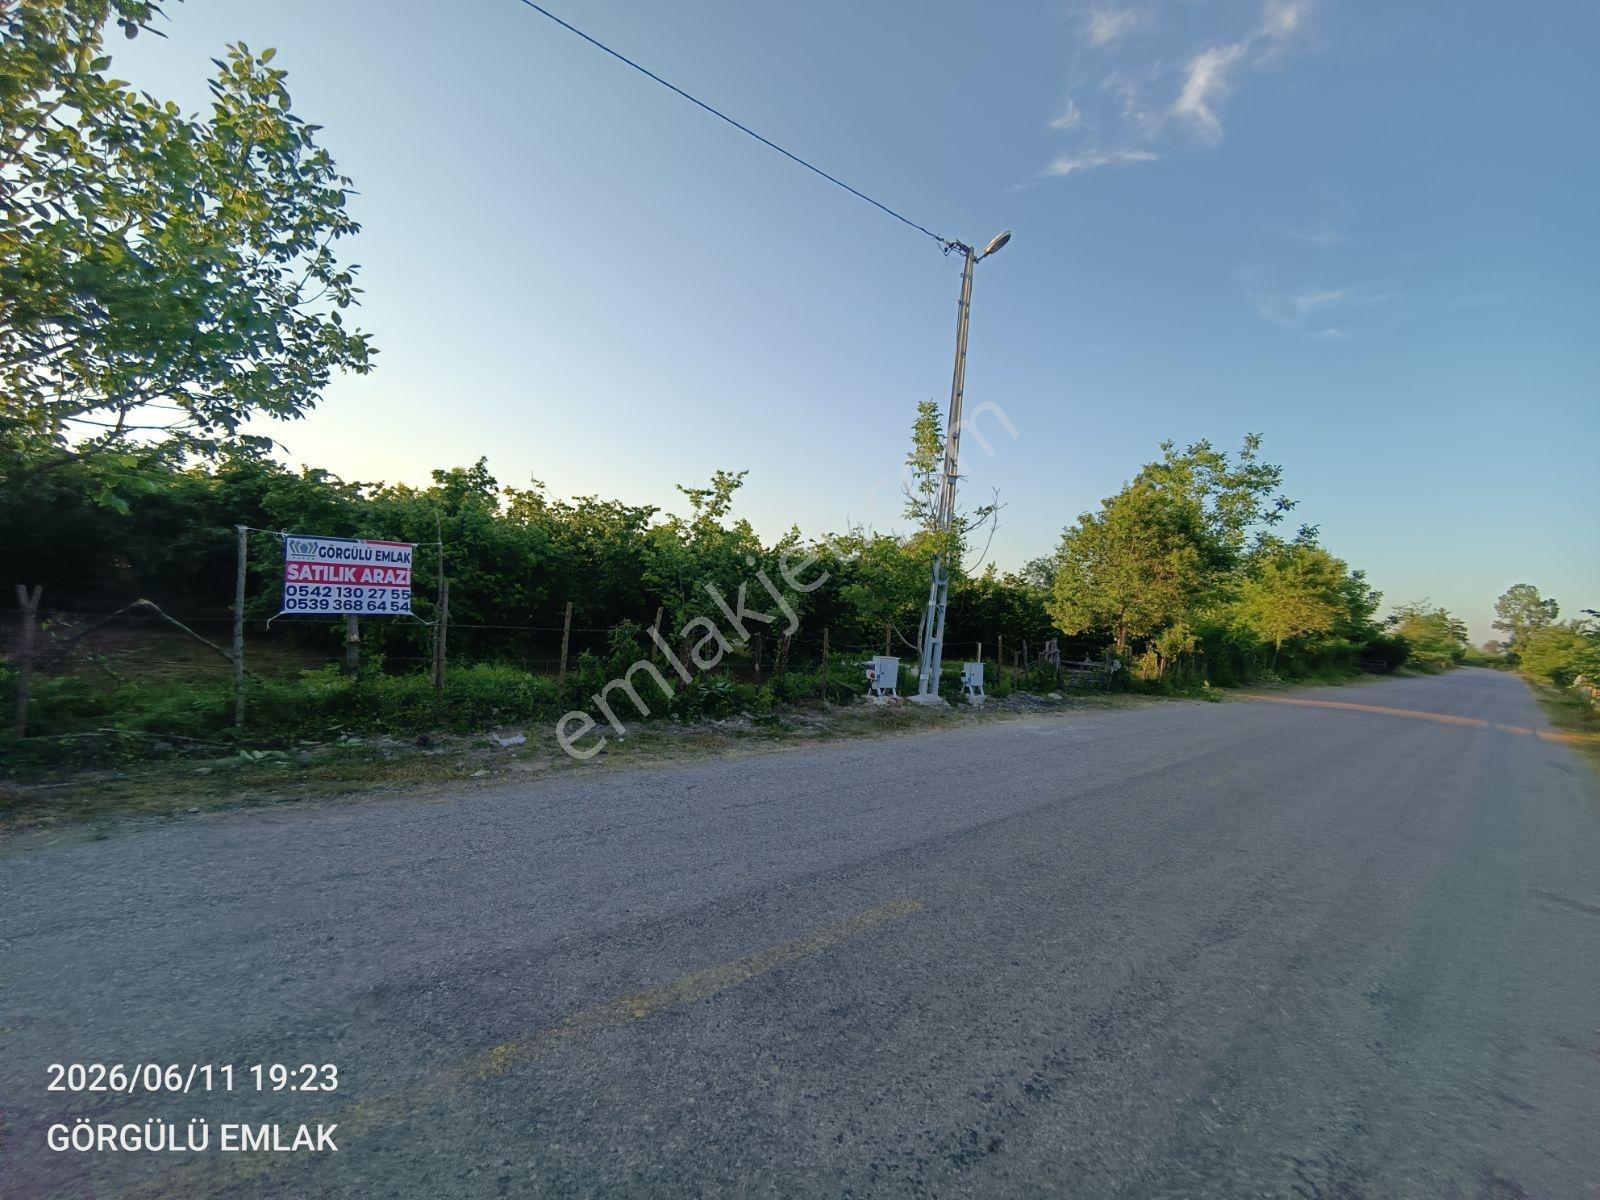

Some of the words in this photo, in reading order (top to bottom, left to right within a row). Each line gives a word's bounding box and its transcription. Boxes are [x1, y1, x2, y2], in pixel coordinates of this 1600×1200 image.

[318, 544, 372, 560] GÖRGÜLÜ
[375, 551, 411, 564] EMLAK
[287, 564, 357, 583] SATILIK
[286, 585, 332, 598] 0542
[336, 587, 364, 599] 130
[368, 588, 386, 600] 27
[391, 589, 410, 600] 55
[286, 598, 330, 610] 0539
[333, 599, 364, 611] 368
[367, 600, 387, 612] 64
[390, 601, 410, 612] 54
